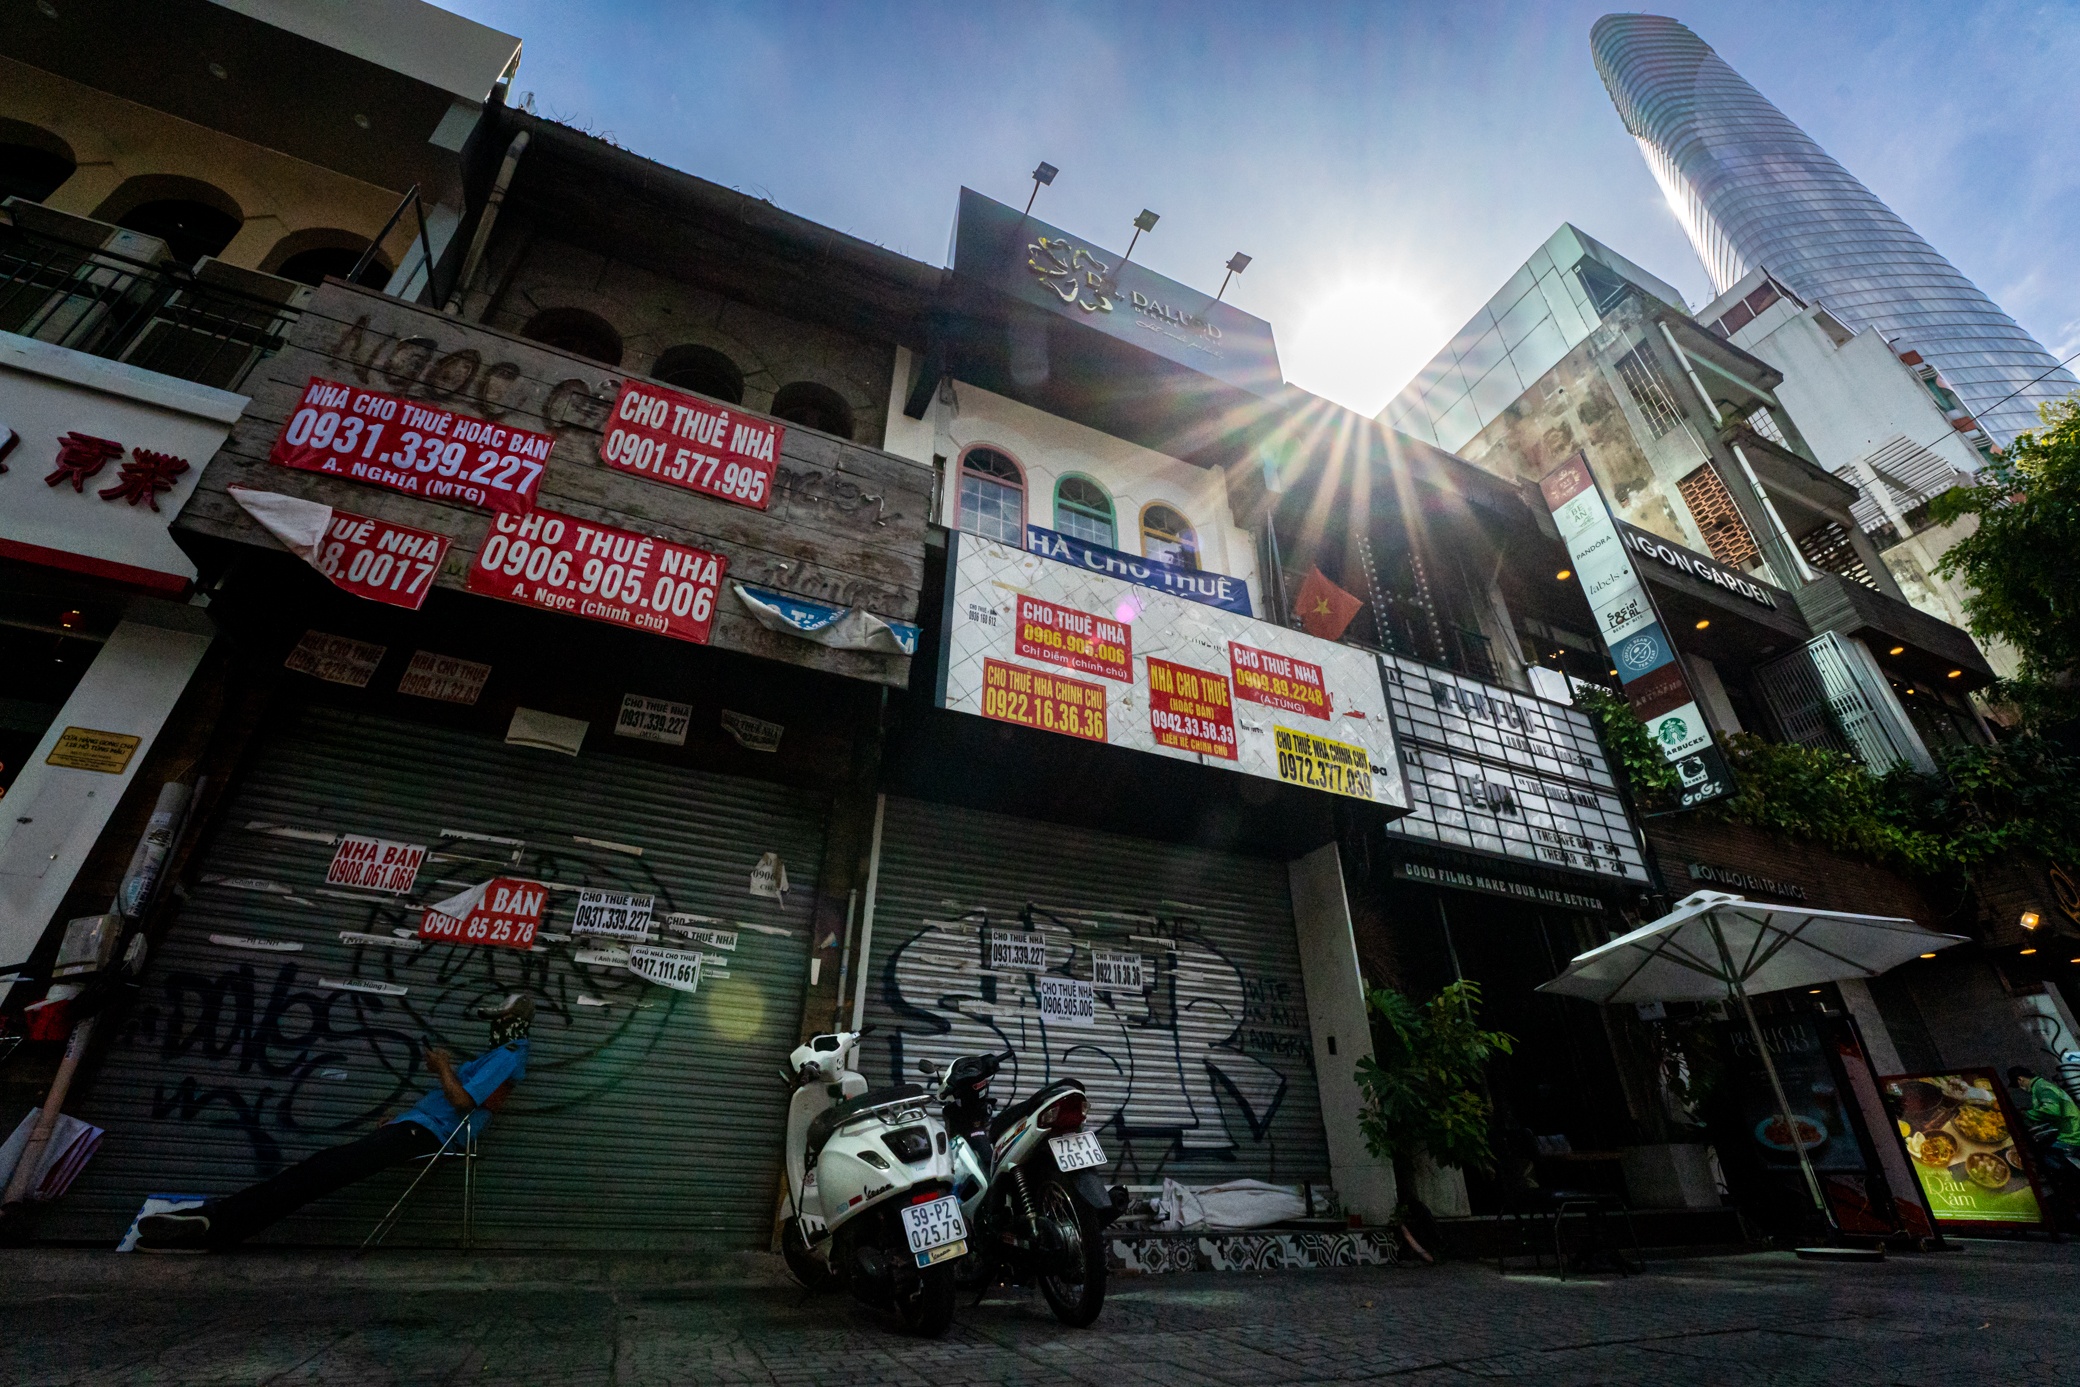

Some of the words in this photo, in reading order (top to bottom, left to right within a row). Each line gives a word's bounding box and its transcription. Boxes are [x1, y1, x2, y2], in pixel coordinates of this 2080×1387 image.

[305, 383, 350, 409] NHÀ
[354, 394, 396, 421] CHO
[401, 405, 452, 436] THUÊ
[452, 419, 506, 449] HOẶC
[508, 433, 551, 460] BÁN
[620, 391, 668, 430] CHO
[670, 405, 729, 445] THUÊ
[730, 424, 776, 462] NHÀ
[285, 409, 543, 495] 0931.339.227
[606, 430, 766, 502] 0901.577.995
[322, 458, 342, 472] A.
[352, 463, 417, 490] NGHĨA
[425, 479, 486, 505] (MTG)
[376, 530, 440, 562] NHÀ
[495, 513, 565, 546] CHO
[576, 525, 655, 568] THUÊ
[662, 549, 718, 586] NHÀ
[1576, 534, 1612, 561] PANDORA
[480, 535, 715, 622] 0906.905.006
[1589, 572, 1620, 596] labels
[1693, 560, 1778, 610] GARDEN
[511, 582, 530, 599] A.
[535, 586, 576, 612] Ngọc
[580, 598, 631, 629] (chính
[634, 610, 669, 634] chủ)
[1023, 602, 1053, 625] CHO
[1058, 611, 1093, 637] THUÊ
[1097, 623, 1126, 645] NHÀ
[1607, 598, 1638, 620] Social
[1024, 624, 1125, 665] 0906.905.006
[1612, 624, 1625, 634] BEER
[437, 660, 459, 676] CHO
[1071, 656, 1103, 673] (chính
[1106, 665, 1128, 680] chủ)
[1234, 648, 1259, 669] CHO
[1261, 653, 1292, 676] THUÊ
[1295, 664, 1319, 685] NHÀ
[987, 665, 1006, 686] CHO
[1009, 671, 1032, 692] THUÊ
[1034, 676, 1053, 697] NHÀ
[1056, 679, 1083, 702] CHÍNH
[1086, 687, 1103, 710] CHỦ
[1150, 663, 1174, 694] NHÀ
[1176, 674, 1199, 700] CHO
[1201, 676, 1229, 707] THUÊ
[1235, 667, 1324, 707] 0909.89.2248
[619, 708, 687, 736] 0931.339.227
[624, 697, 644, 709] CHO
[645, 699, 669, 714] THUÊ
[670, 705, 690, 717] NHÀ
[986, 687, 1104, 739] 0922.16.36.36
[1431, 681, 1537, 734] MUNICH
[1152, 710, 1234, 745] 0942.33.58.33
[1191, 737, 1212, 754] CHÍNH
[1276, 730, 1292, 751] CHO
[1293, 736, 1313, 756] THUÊ
[1313, 740, 1330, 758] NHÀ
[1330, 743, 1353, 765] CHÍNH
[1279, 750, 1372, 798] 0972.377.039
[1456, 772, 1517, 816] LÉON
[339, 839, 380, 862] NHÀ
[383, 844, 423, 870] BÁN
[328, 859, 414, 892] 0908.061.068
[1405, 863, 1436, 880] GOOD
[1438, 869, 1474, 886] FILMS
[1476, 876, 1506, 892] MAKE
[1508, 882, 1536, 898] YOUR
[1537, 889, 1562, 903] LIFE
[1564, 893, 1604, 910] BETTER
[491, 885, 543, 917] BÁN
[581, 891, 603, 903] CHO
[605, 892, 630, 905] THUÊ
[467, 917, 488, 939] 85
[491, 919, 511, 940] 25
[513, 922, 535, 943] 78
[576, 904, 650, 932] 0931.339.227
[691, 930, 715, 944] THUÊ
[716, 932, 735, 946] NHÀ
[993, 932, 1008, 941] CHO
[1010, 934, 1028, 943] THUÊ
[631, 955, 697, 984] 0917.111.661
[665, 952, 679, 960] CHO
[679, 953, 696, 962] THUÊ
[993, 944, 1044, 966] 0931.339.227
[1042, 982, 1057, 995] CHO
[1059, 981, 1077, 997] THUÊ
[1078, 983, 1093, 998] NHÀ
[1095, 962, 1140, 986] 0922.16.36.36
[1043, 996, 1093, 1017] 0906.905.006
[1057, 1136, 1091, 1153] 72-F1
[1058, 1149, 1103, 1170] 505.16
[911, 1201, 953, 1227] 59-P2
[911, 1218, 963, 1249] 025.79
